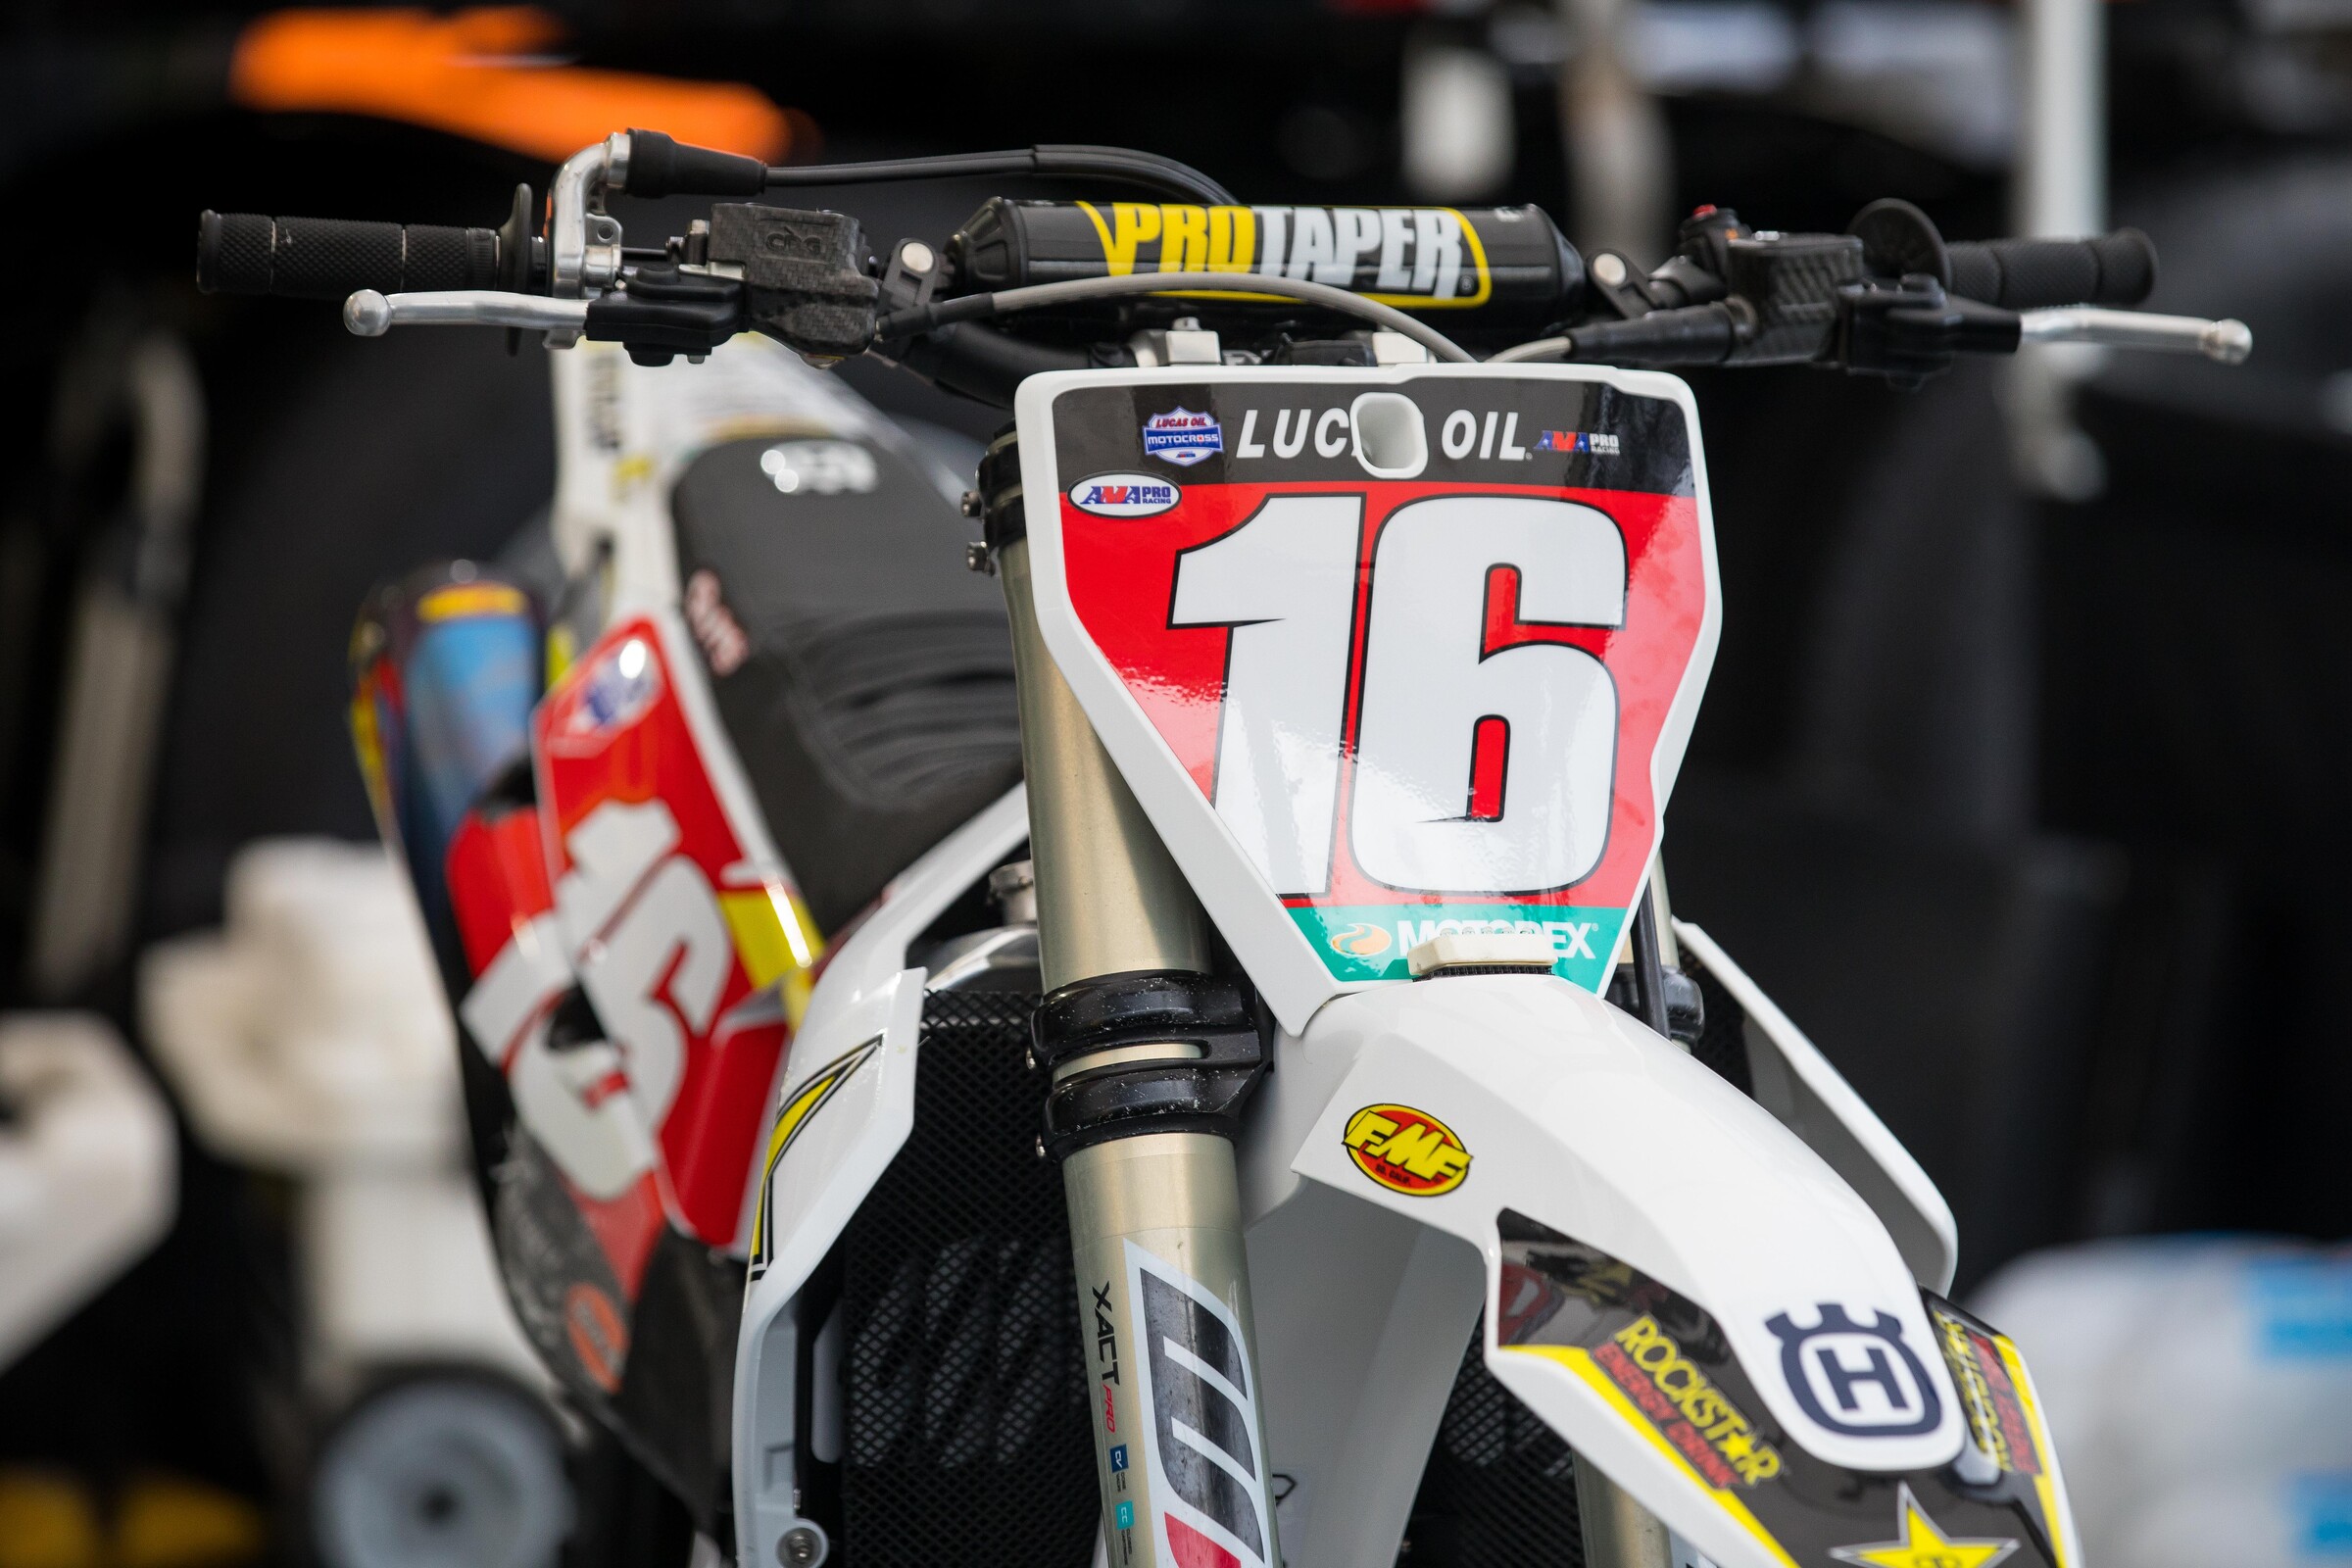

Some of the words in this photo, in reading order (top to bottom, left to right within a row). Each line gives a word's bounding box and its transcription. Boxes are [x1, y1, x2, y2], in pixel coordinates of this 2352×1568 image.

[1148, 433, 1219, 445] MOTOCROSS
[1154, 416, 1188, 429] LUCAS
[1191, 416, 1207, 427] OIL
[1236, 407, 1356, 460] LUC
[1441, 409, 1527, 461] OIL
[1533, 429, 1590, 454] AMA
[1590, 433, 1620, 447] PRO
[1591, 446, 1621, 456] RACING
[1080, 485, 1142, 505] AMA
[1142, 486, 1172, 498] PRO
[1166, 491, 1630, 899] 16
[1342, 1110, 1474, 1182] FMF
[1092, 1280, 1120, 1386] XACT
[1102, 1384, 1116, 1434] PRO
